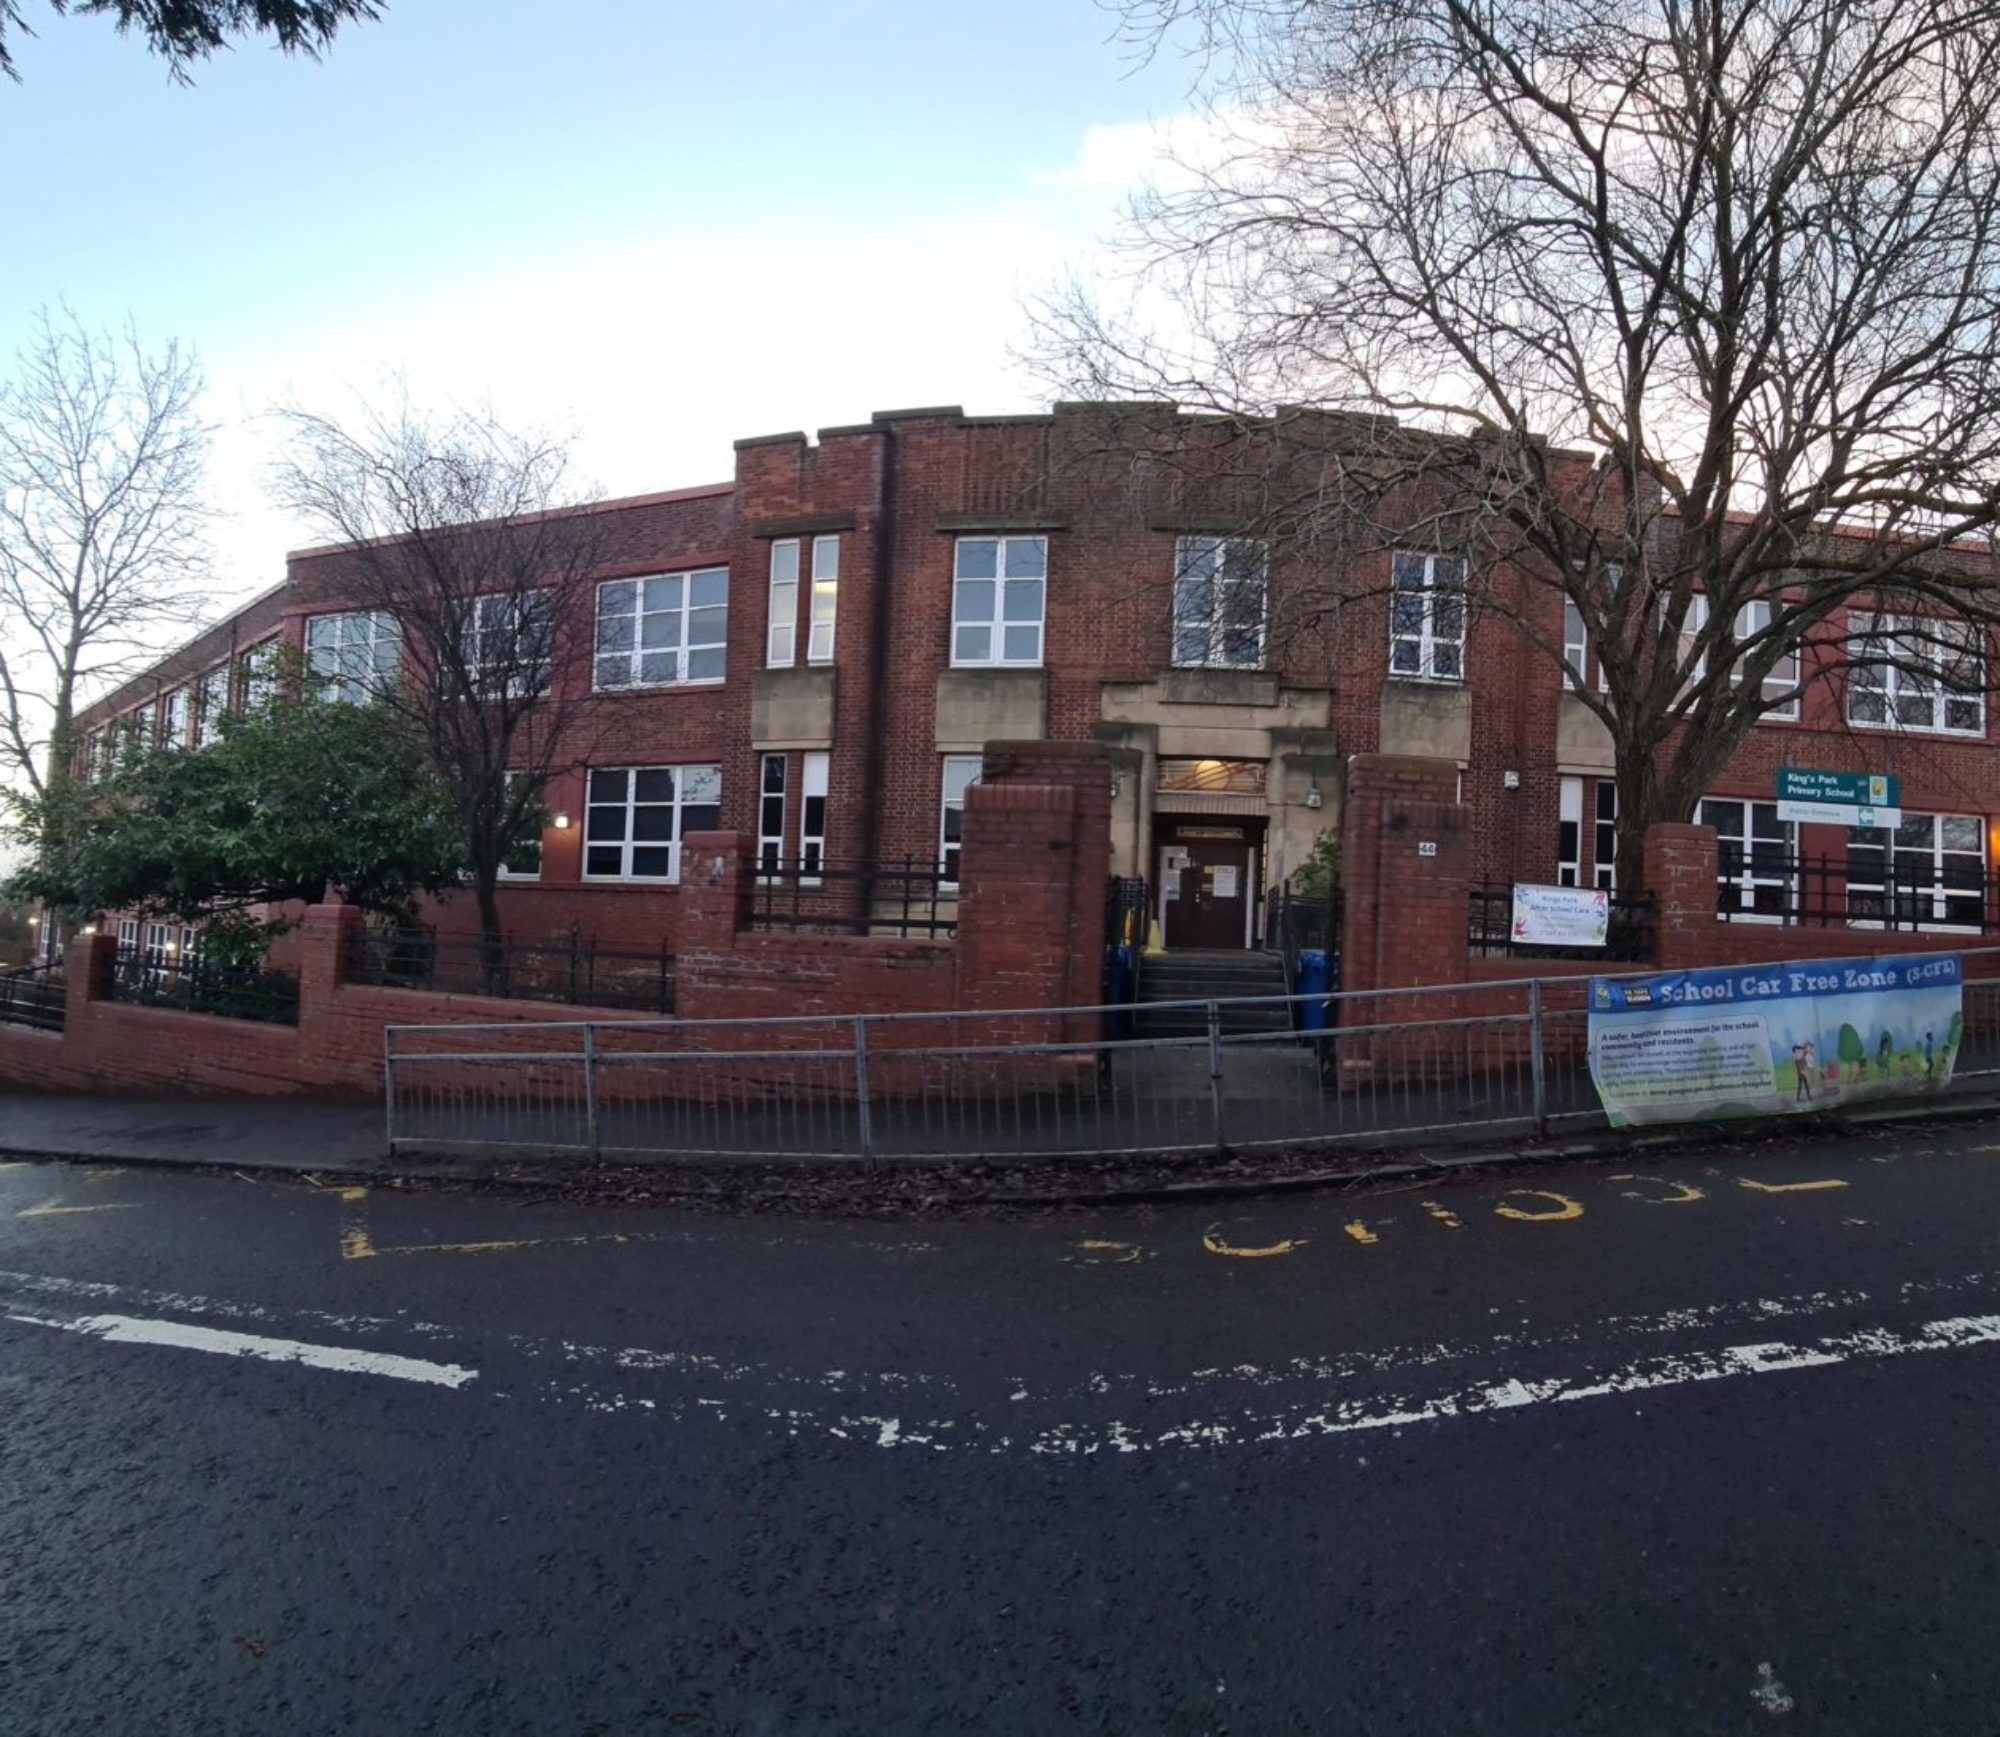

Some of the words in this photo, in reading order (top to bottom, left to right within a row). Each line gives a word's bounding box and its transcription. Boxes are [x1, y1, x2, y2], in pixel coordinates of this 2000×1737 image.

[1787, 773, 1815, 785] King's
[1818, 775, 1838, 785] Park
[1787, 785, 1822, 797] Primary
[1825, 788, 1855, 798] School
[1551, 905, 1573, 913] School
[1660, 978, 1734, 1003] School
[1741, 976, 1782, 996] Car
[1789, 972, 1839, 993] Free
[1844, 969, 1897, 988] Zone
